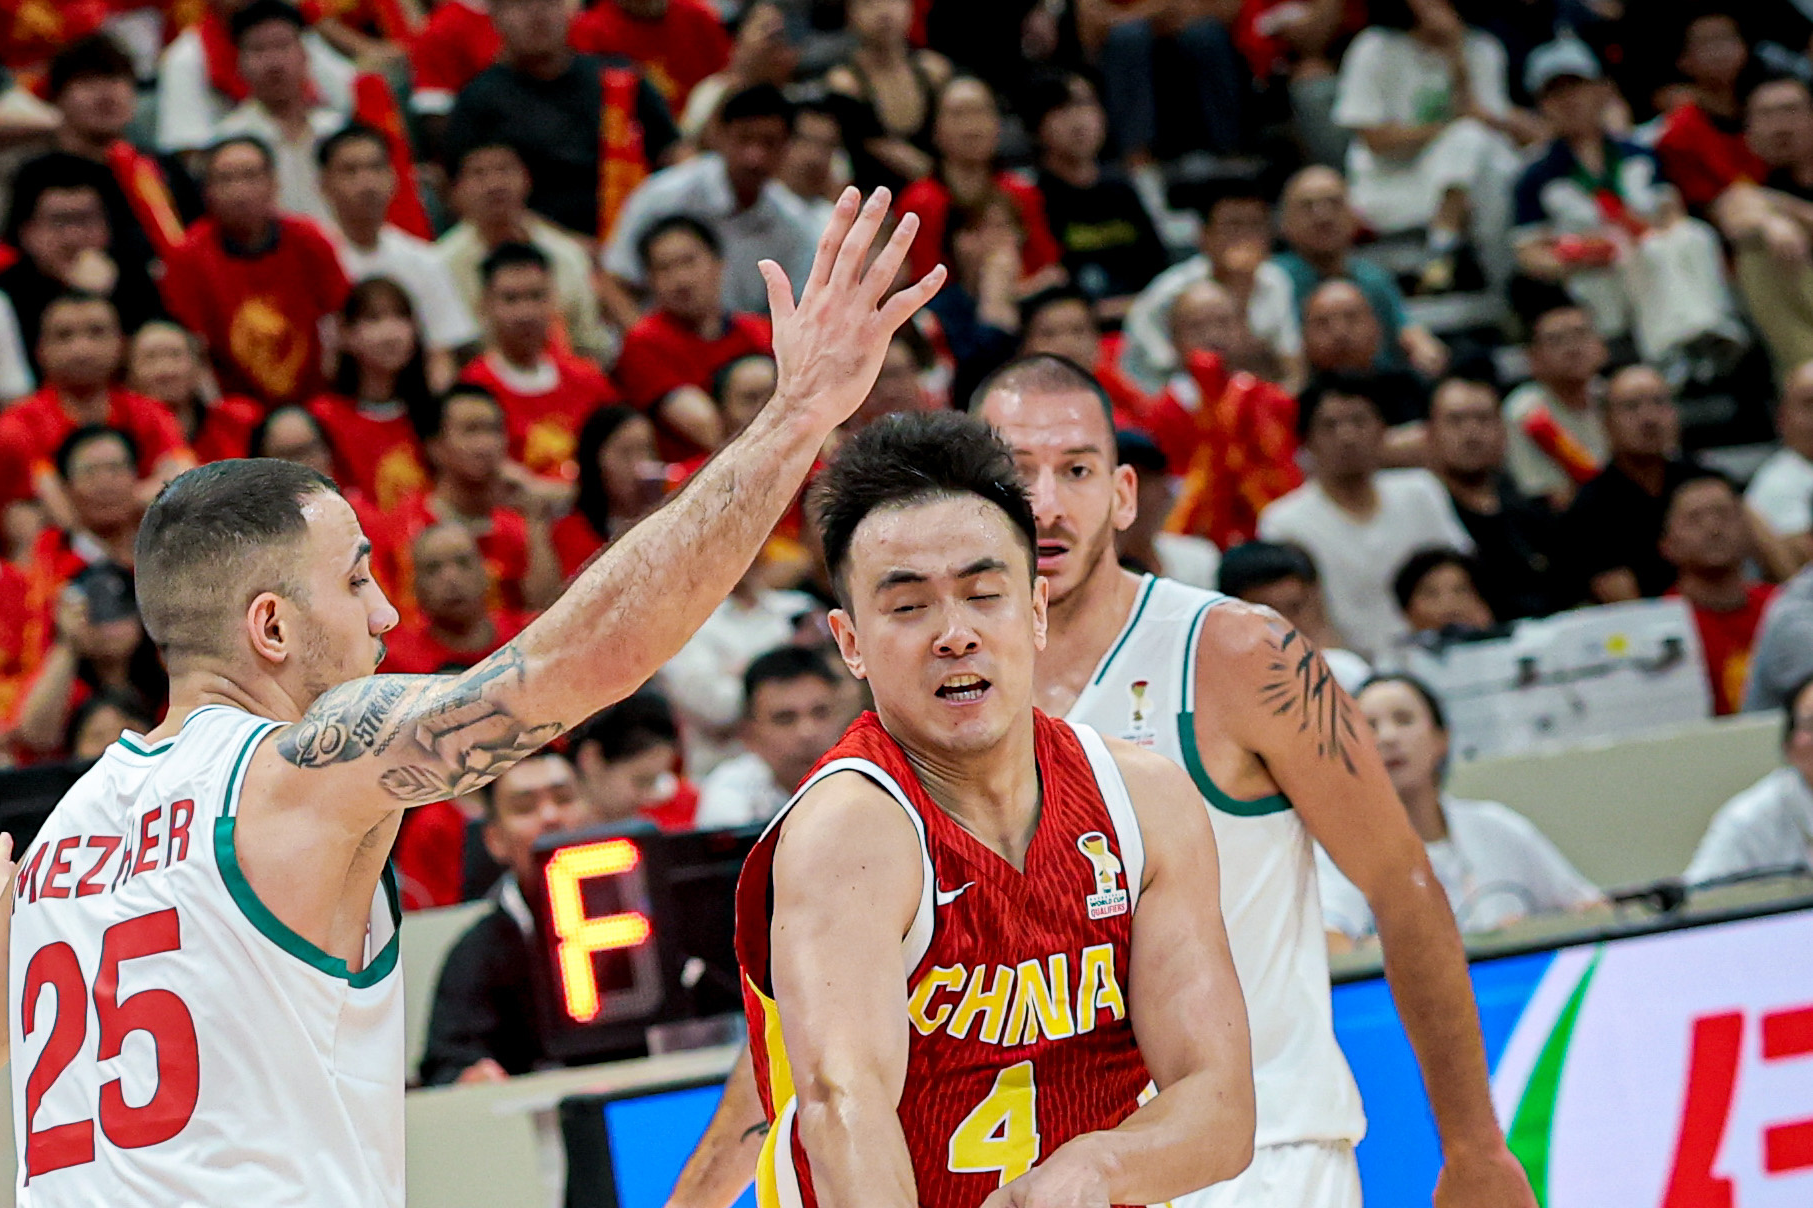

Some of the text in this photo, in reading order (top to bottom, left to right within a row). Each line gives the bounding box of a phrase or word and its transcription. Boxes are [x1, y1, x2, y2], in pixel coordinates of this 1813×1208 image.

[11, 798, 195, 916] MEZHER
[544, 837, 652, 1024] F
[21, 906, 201, 1188] 25
[947, 1059, 1041, 1188] 4
